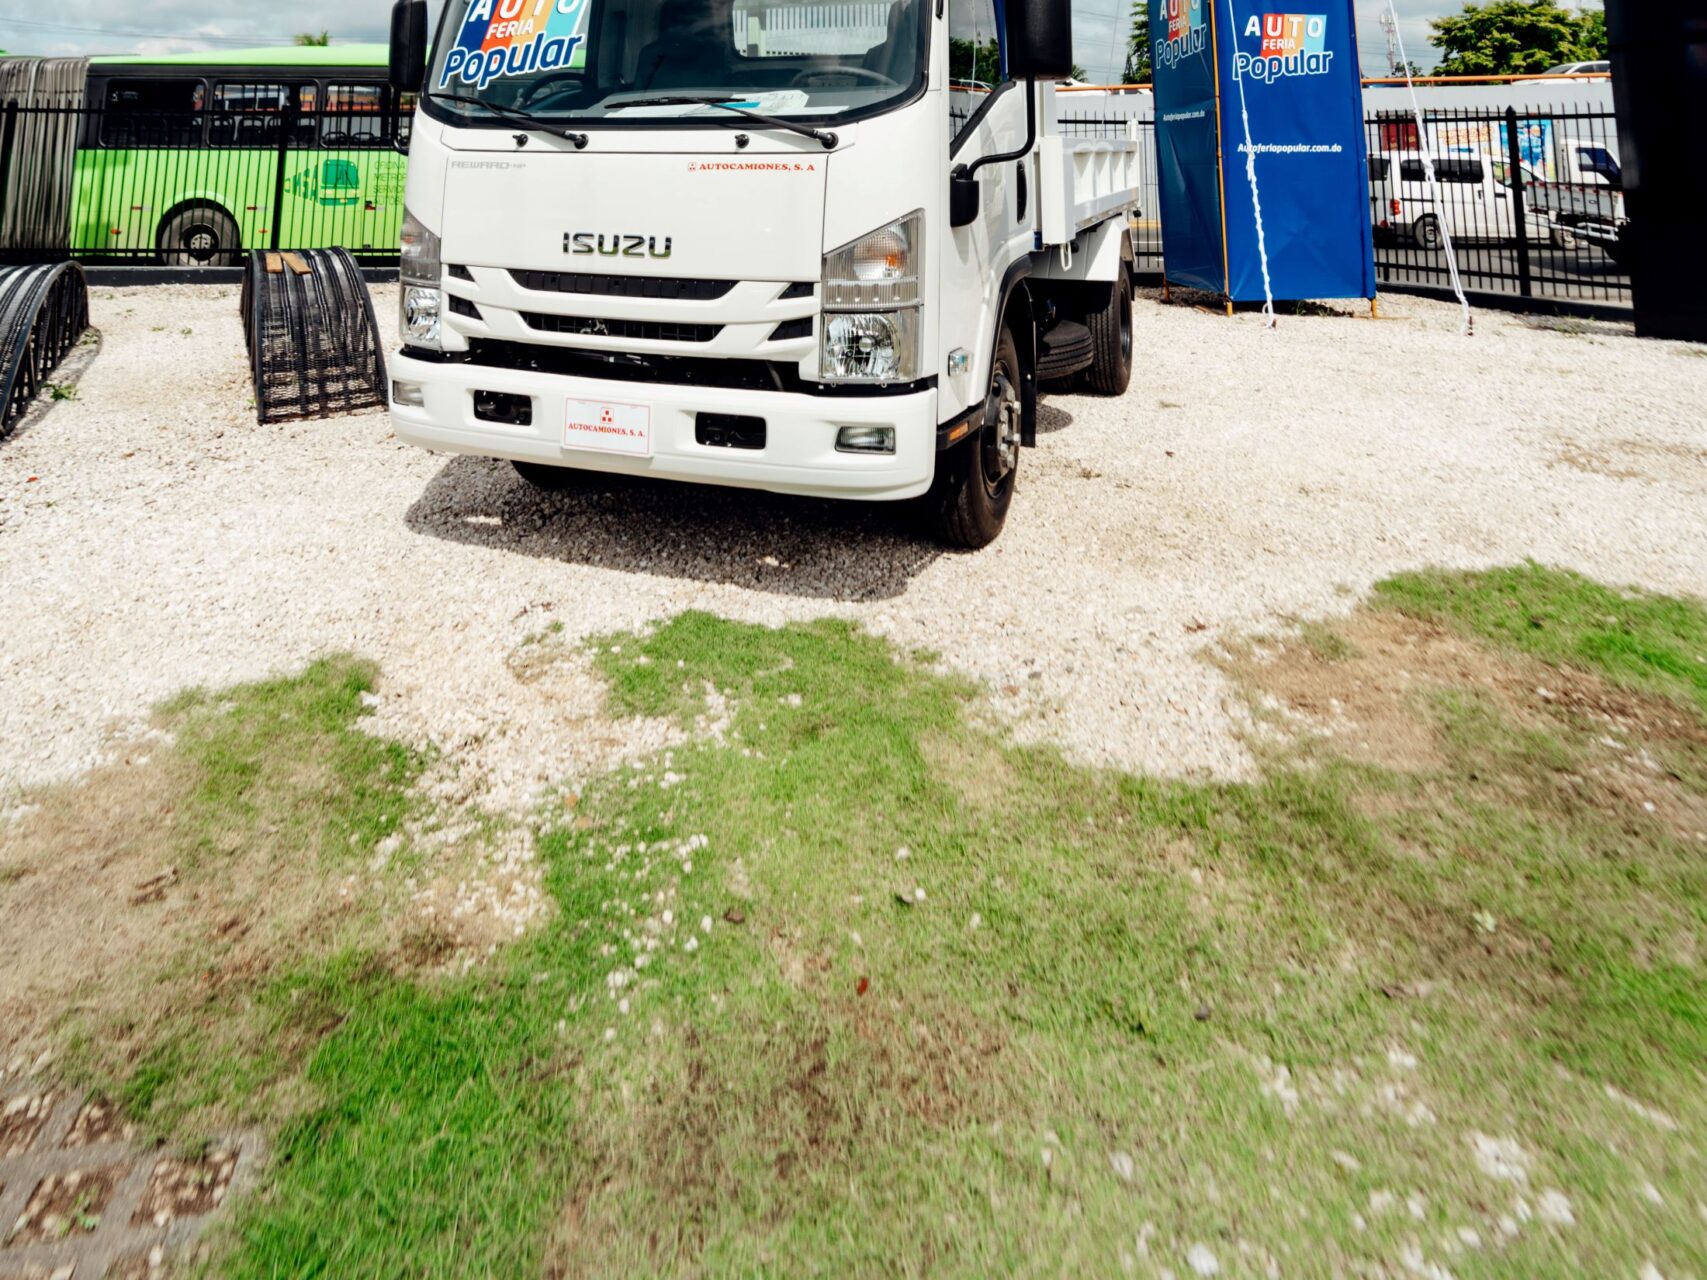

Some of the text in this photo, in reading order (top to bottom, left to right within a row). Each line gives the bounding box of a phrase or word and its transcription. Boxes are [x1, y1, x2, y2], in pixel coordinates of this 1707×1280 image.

[485, 18, 534, 40] FERIA
[1168, 16, 1187, 33] FERIA
[1244, 15, 1324, 38] AUTO
[1155, 23, 1207, 69] Popular
[1262, 38, 1296, 50] FERIA
[438, 30, 586, 90] Popular
[1232, 48, 1333, 84] Popular
[1237, 143, 1343, 154] Auoferiapopular.com.do
[699, 162, 791, 172] AUTOCAMIONES,
[794, 163, 804, 171] S.
[562, 232, 673, 259] ISUZU
[568, 423, 629, 436] AUTOCAMIONES,
